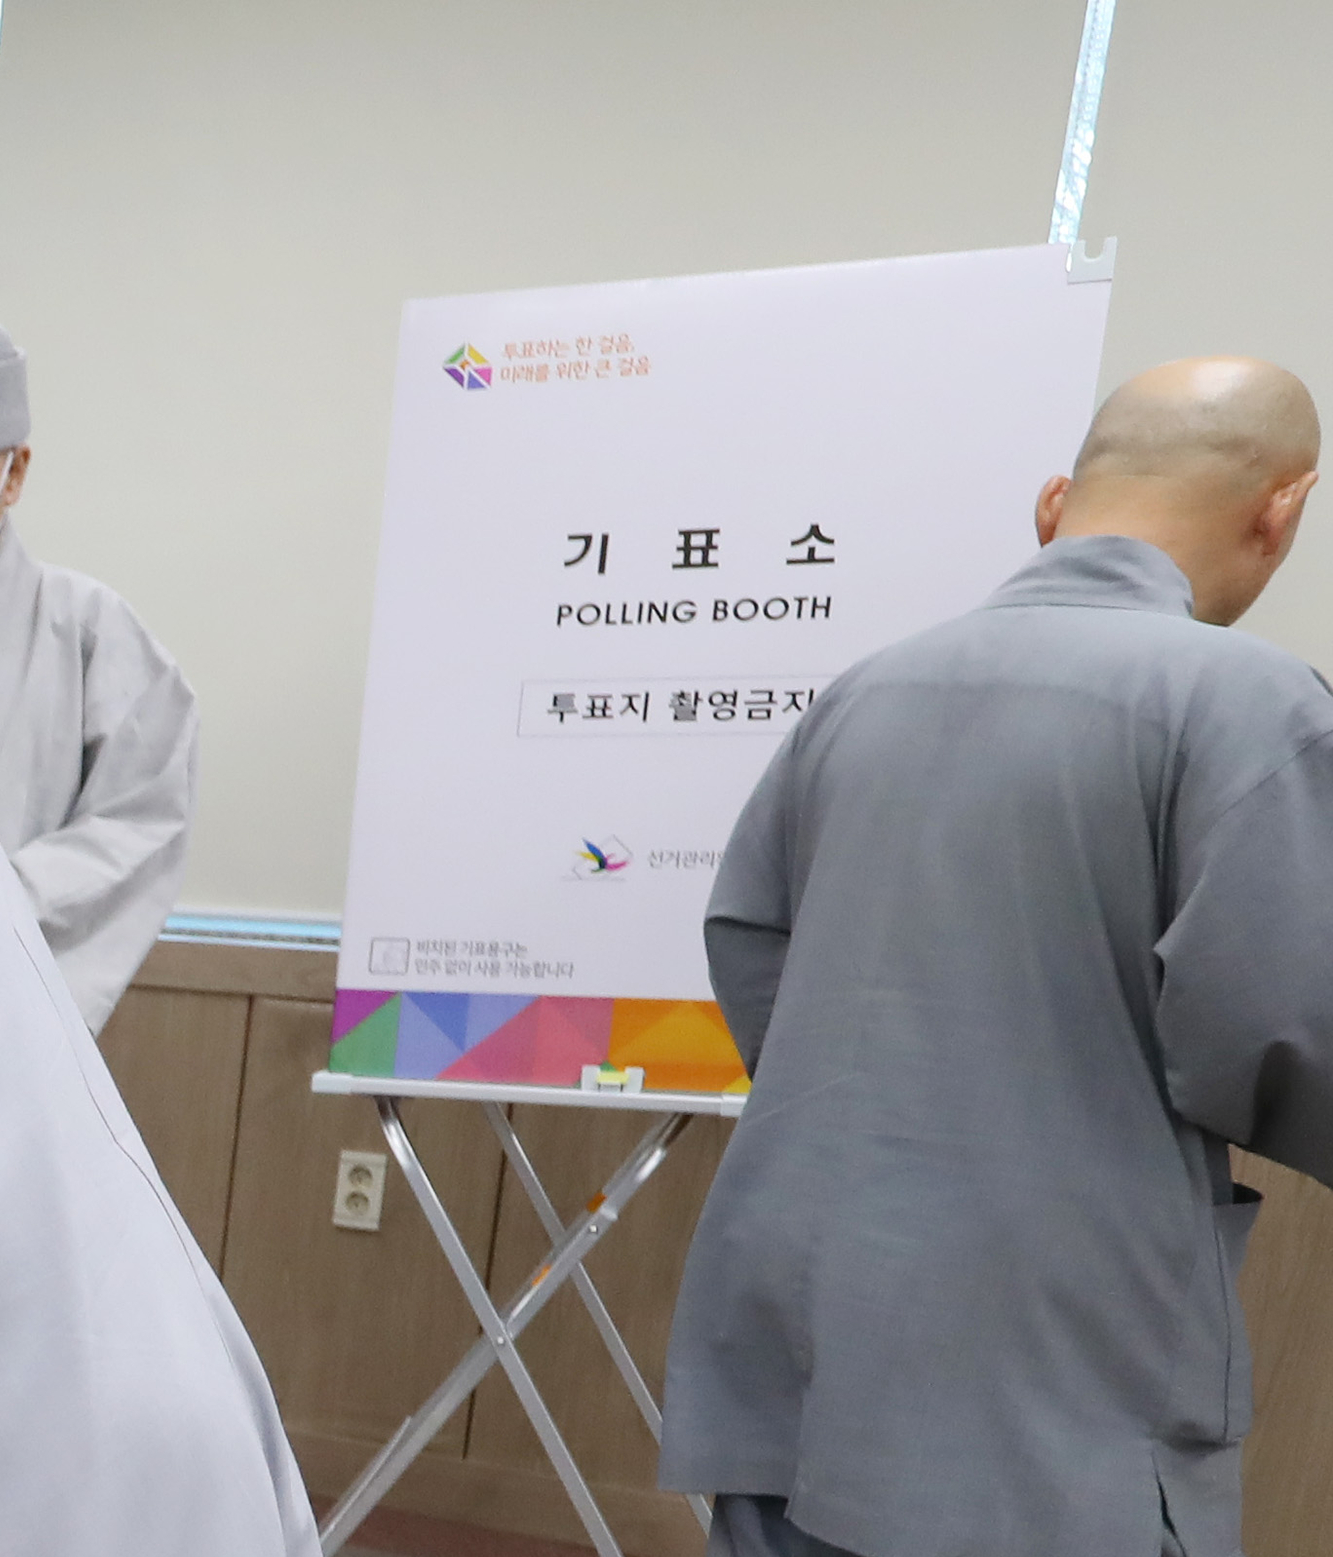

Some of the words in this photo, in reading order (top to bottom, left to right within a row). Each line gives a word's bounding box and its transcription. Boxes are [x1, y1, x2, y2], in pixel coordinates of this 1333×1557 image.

[503, 339, 570, 360] 투표하는
[576, 335, 593, 356] 한
[500, 363, 549, 383] 미래를
[556, 360, 589, 380] 위한
[595, 358, 612, 378] 큰
[619, 355, 650, 377] 걸음
[556, 600, 698, 626] POLLING
[712, 596, 831, 622] BOOTH
[547, 691, 650, 723] 투표지
